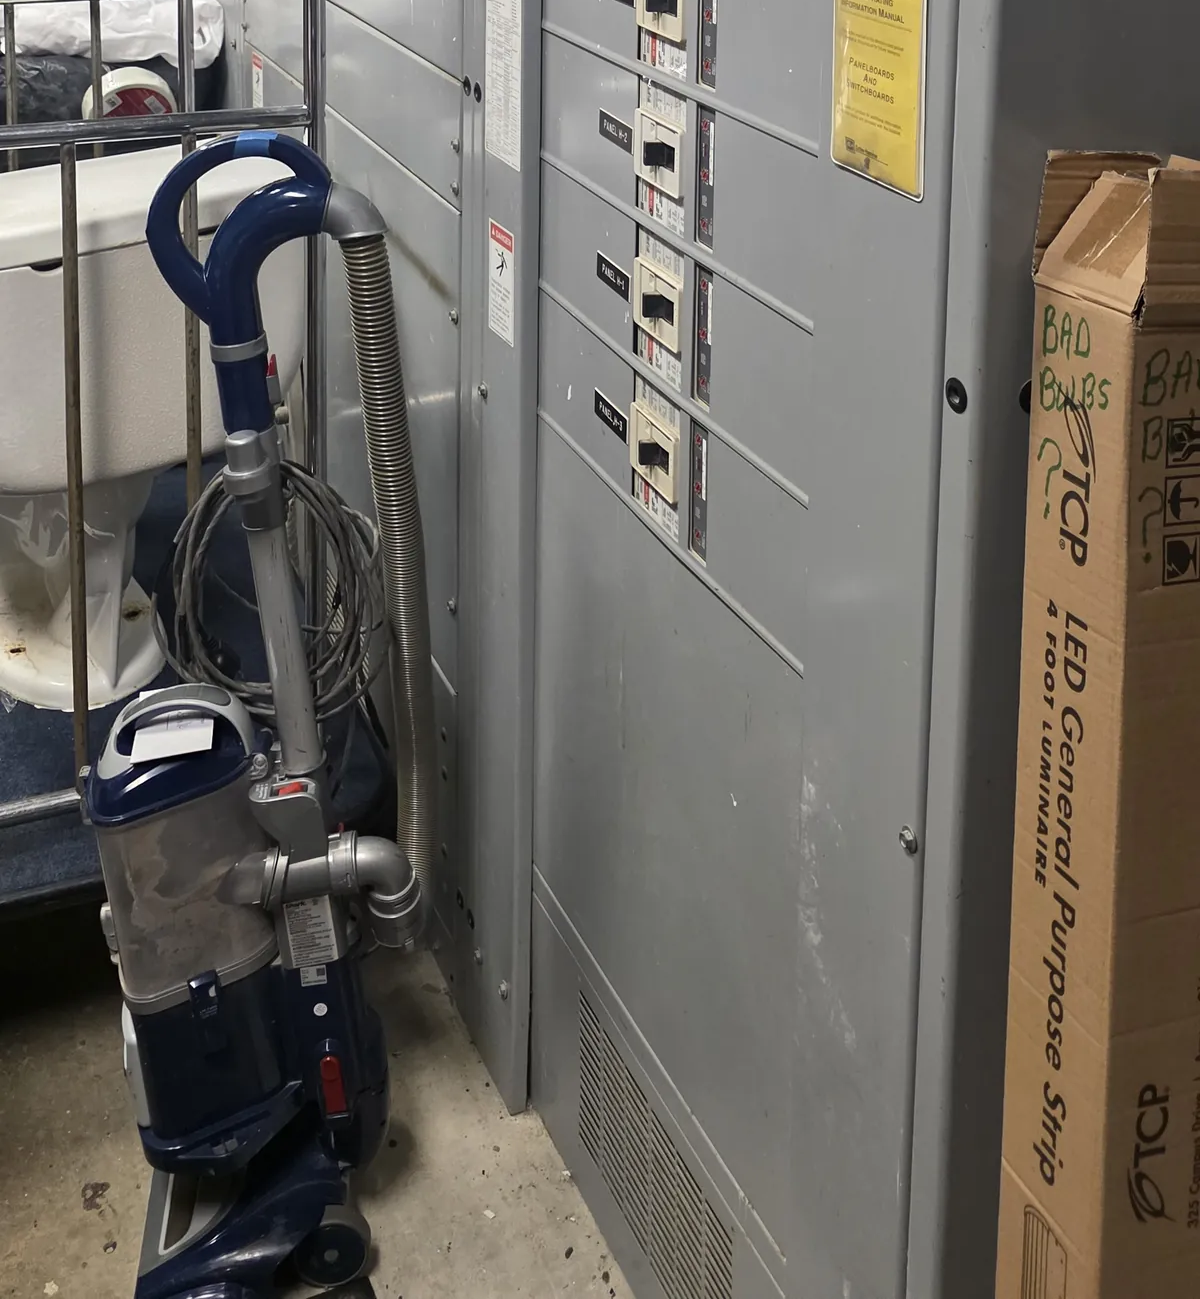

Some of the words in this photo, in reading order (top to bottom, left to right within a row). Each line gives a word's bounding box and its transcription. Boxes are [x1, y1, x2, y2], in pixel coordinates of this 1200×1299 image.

[878, 7, 905, 25] MANUAL
[849, 56, 895, 81] PANELBOARDS
[862, 73, 878, 87] AND
[603, 118, 618, 138] PANEL
[602, 262, 616, 284] PANEL
[1042, 304, 1091, 361] BAD
[1040, 365, 1113, 413] BULBS
[1138, 348, 1200, 407] BA
[598, 401, 613, 424] PANEL
[1037, 437, 1062, 520] ?
[1059, 469, 1091, 567] TCP
[1046, 598, 1058, 619] 4
[1043, 630, 1057, 711] FOOT
[1063, 610, 1089, 694] LED
[1034, 720, 1053, 889] LUMINAIRE
[1054, 706, 1084, 891] General
[1043, 890, 1076, 1071] Purpose
[1033, 1081, 1067, 1186] Strip
[1133, 1083, 1170, 1170] TCP
